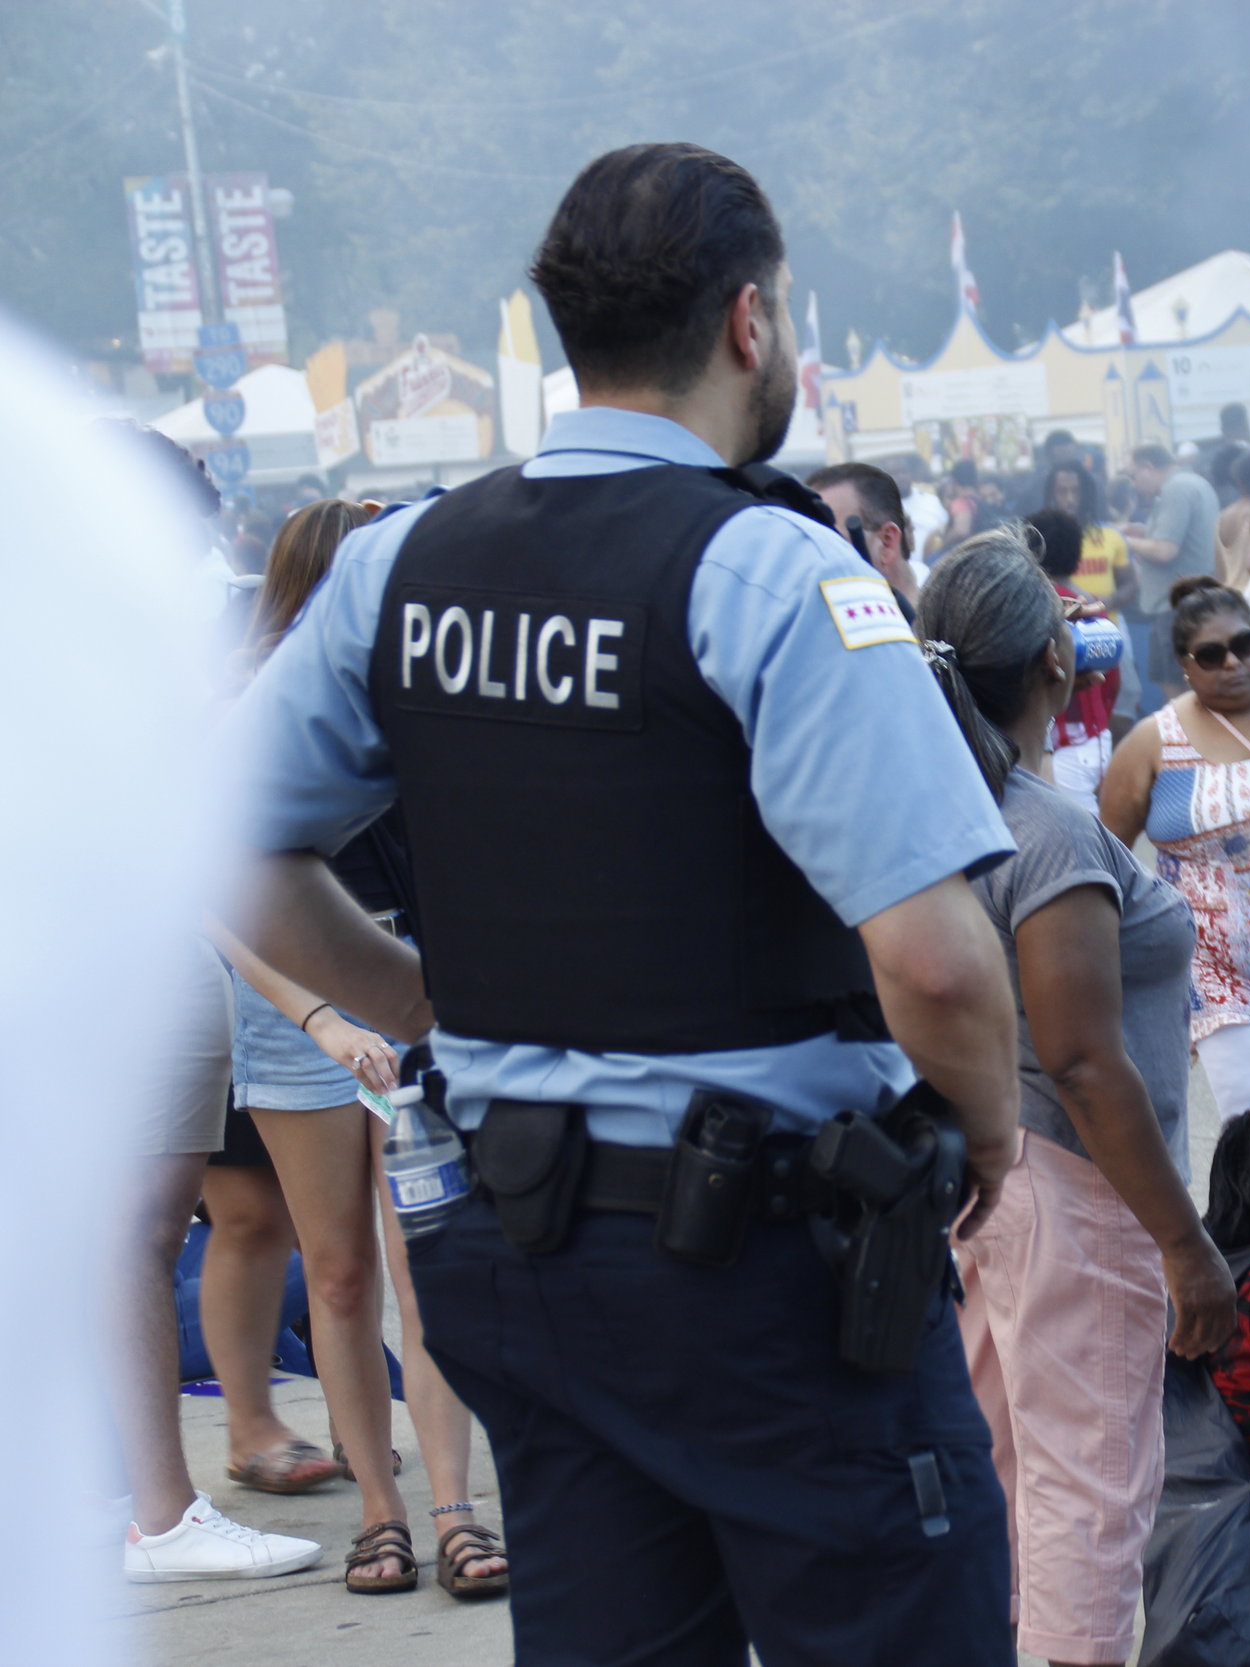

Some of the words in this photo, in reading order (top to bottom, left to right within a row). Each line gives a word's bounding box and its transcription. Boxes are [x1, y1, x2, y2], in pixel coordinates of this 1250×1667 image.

[135, 188, 194, 309] TASTE
[216, 186, 275, 306] TASTE
[205, 354, 241, 379] 290
[1172, 356, 1192, 375] 10
[210, 403, 241, 422] 90
[213, 453, 244, 472] 94
[402, 603, 625, 709] POLICE
